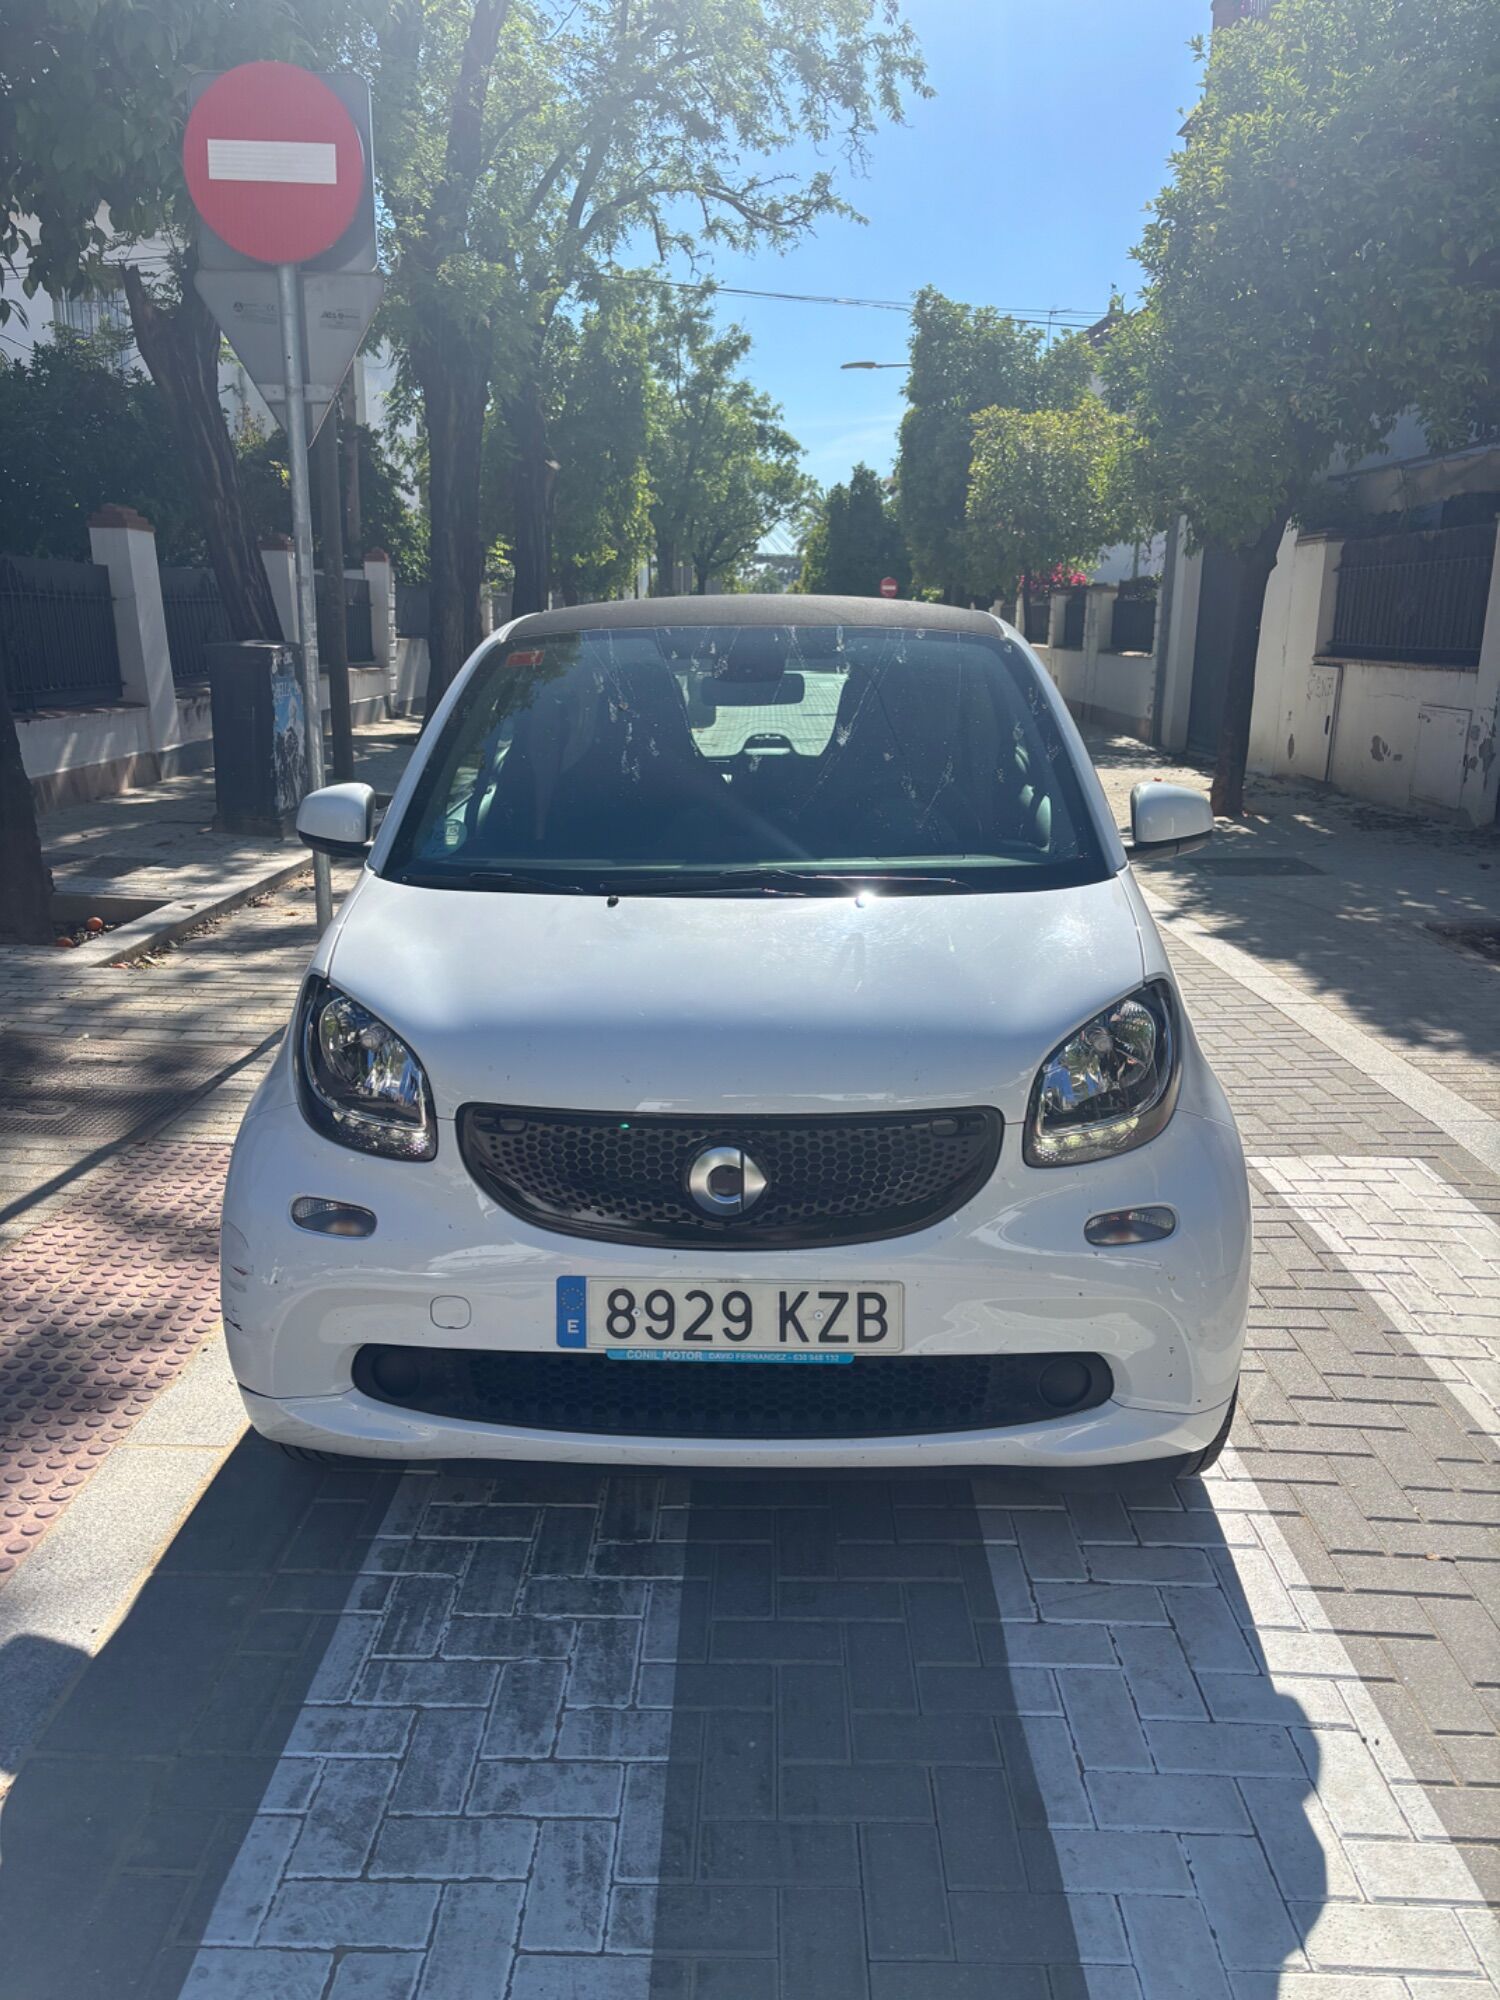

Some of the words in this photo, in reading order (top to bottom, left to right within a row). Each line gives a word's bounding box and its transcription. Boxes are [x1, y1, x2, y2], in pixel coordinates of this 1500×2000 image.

[606, 1287, 753, 1341] 8929
[778, 1290, 888, 1343] KZB
[567, 1319, 580, 1334] E
[626, 1349, 661, 1360] CONIL
[662, 1350, 703, 1361] MOTOR
